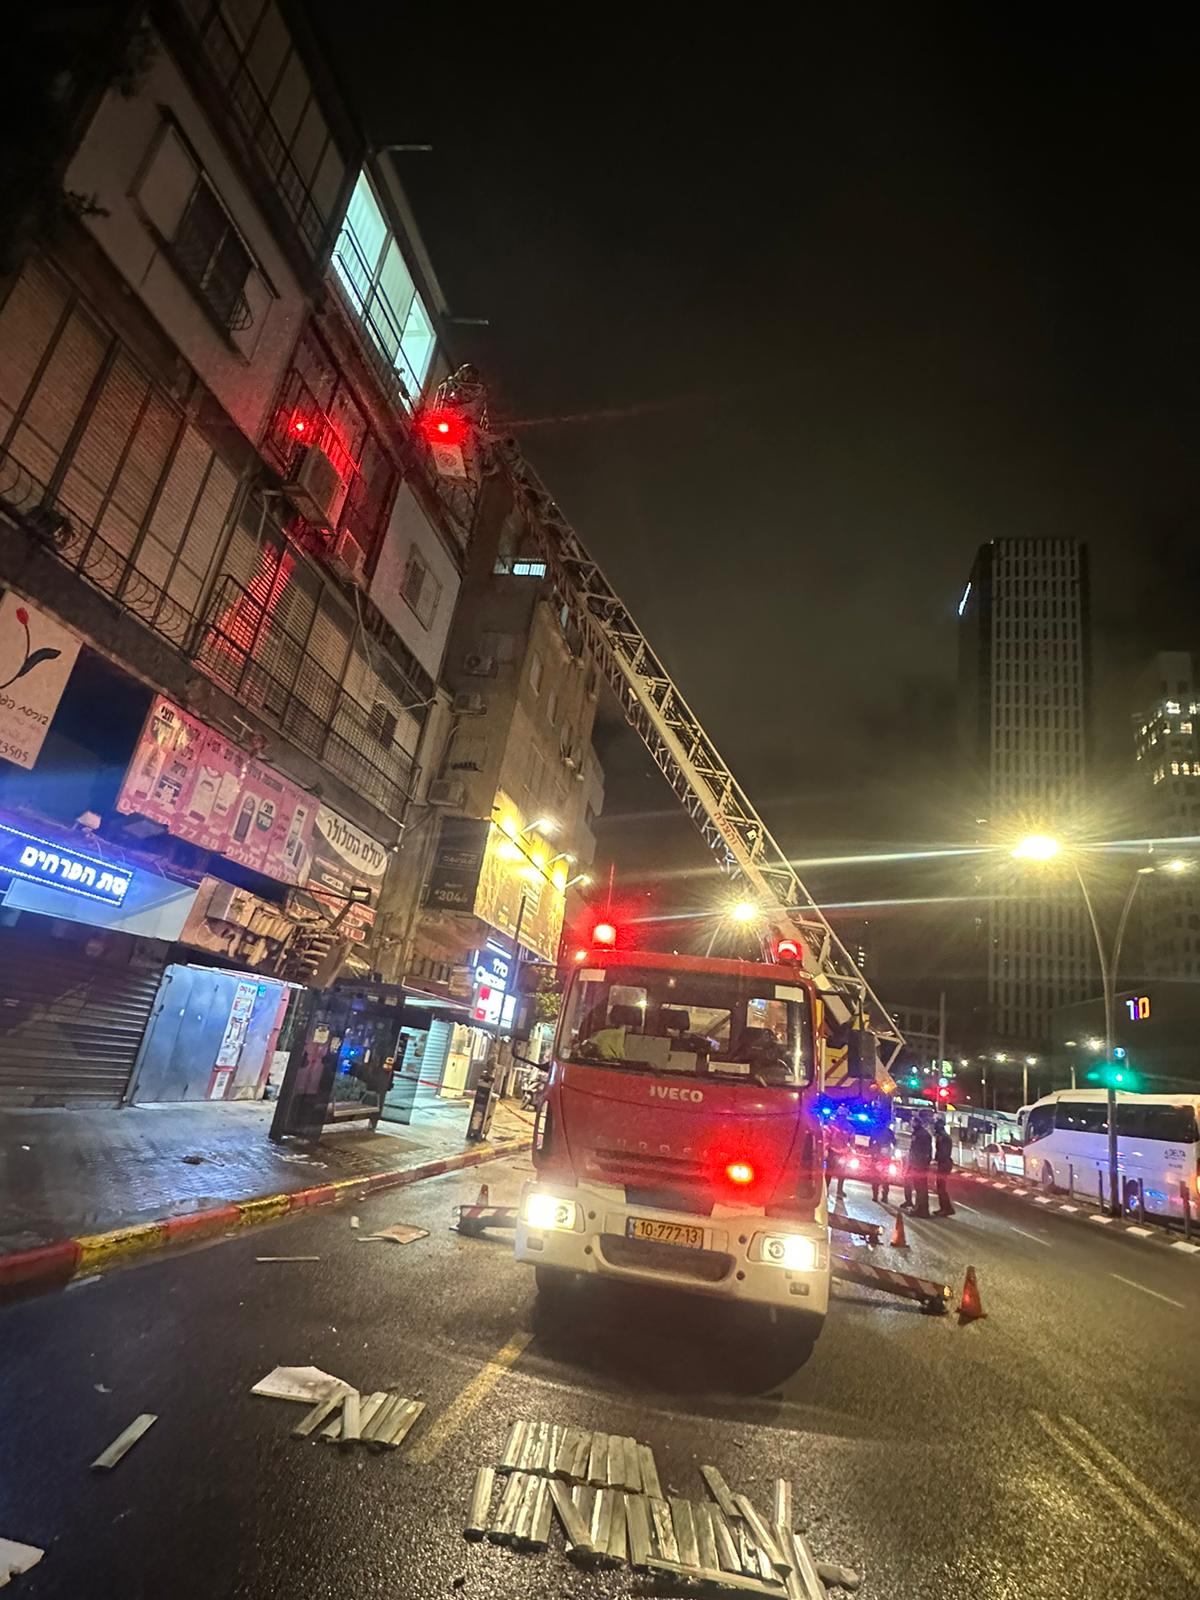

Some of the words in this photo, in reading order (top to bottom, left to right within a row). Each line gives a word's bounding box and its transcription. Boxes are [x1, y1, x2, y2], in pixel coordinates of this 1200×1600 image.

[20, 845, 97, 886] הפרחים
[361, 839, 384, 868] עולם
[649, 1084, 704, 1104] IVECO
